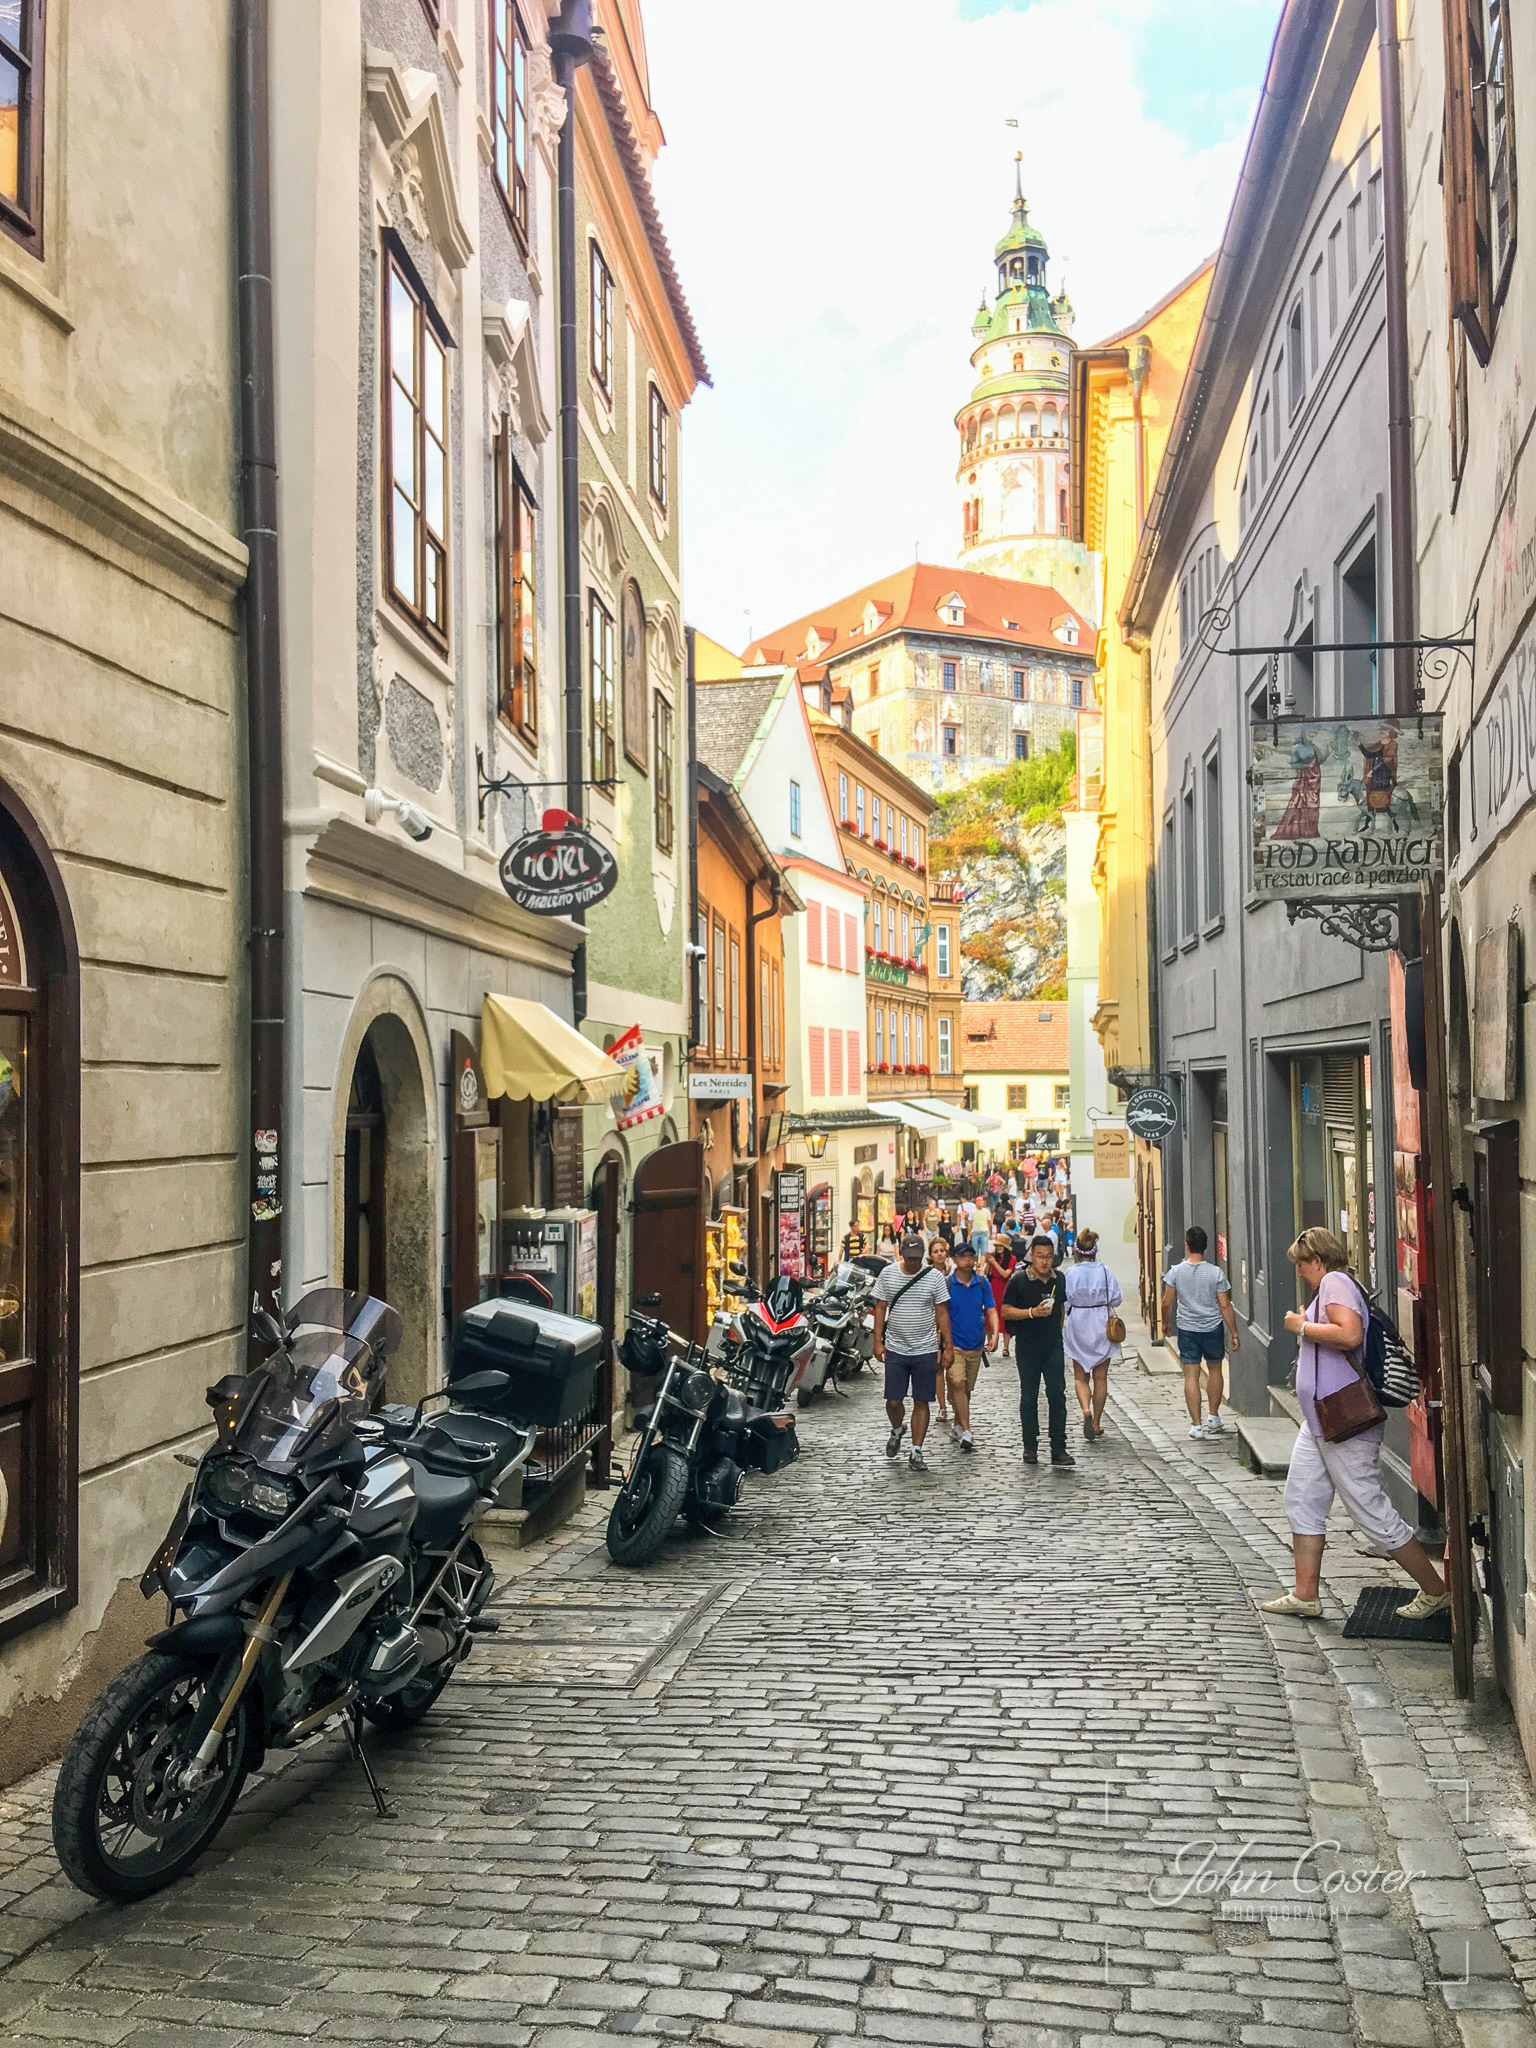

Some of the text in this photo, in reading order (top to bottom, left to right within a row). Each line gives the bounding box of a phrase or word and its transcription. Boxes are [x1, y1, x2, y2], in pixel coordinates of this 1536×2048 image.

[1265, 866, 1432, 889] restaurace a penzion
[516, 890, 527, 903] U
[692, 1078, 748, 1088] Les Néréides
[1131, 1092, 1171, 1107] LONGCHAMP
[1025, 1142, 1059, 1150] SWAROVSKI
[1097, 1152, 1126, 1160] MUSEUM
